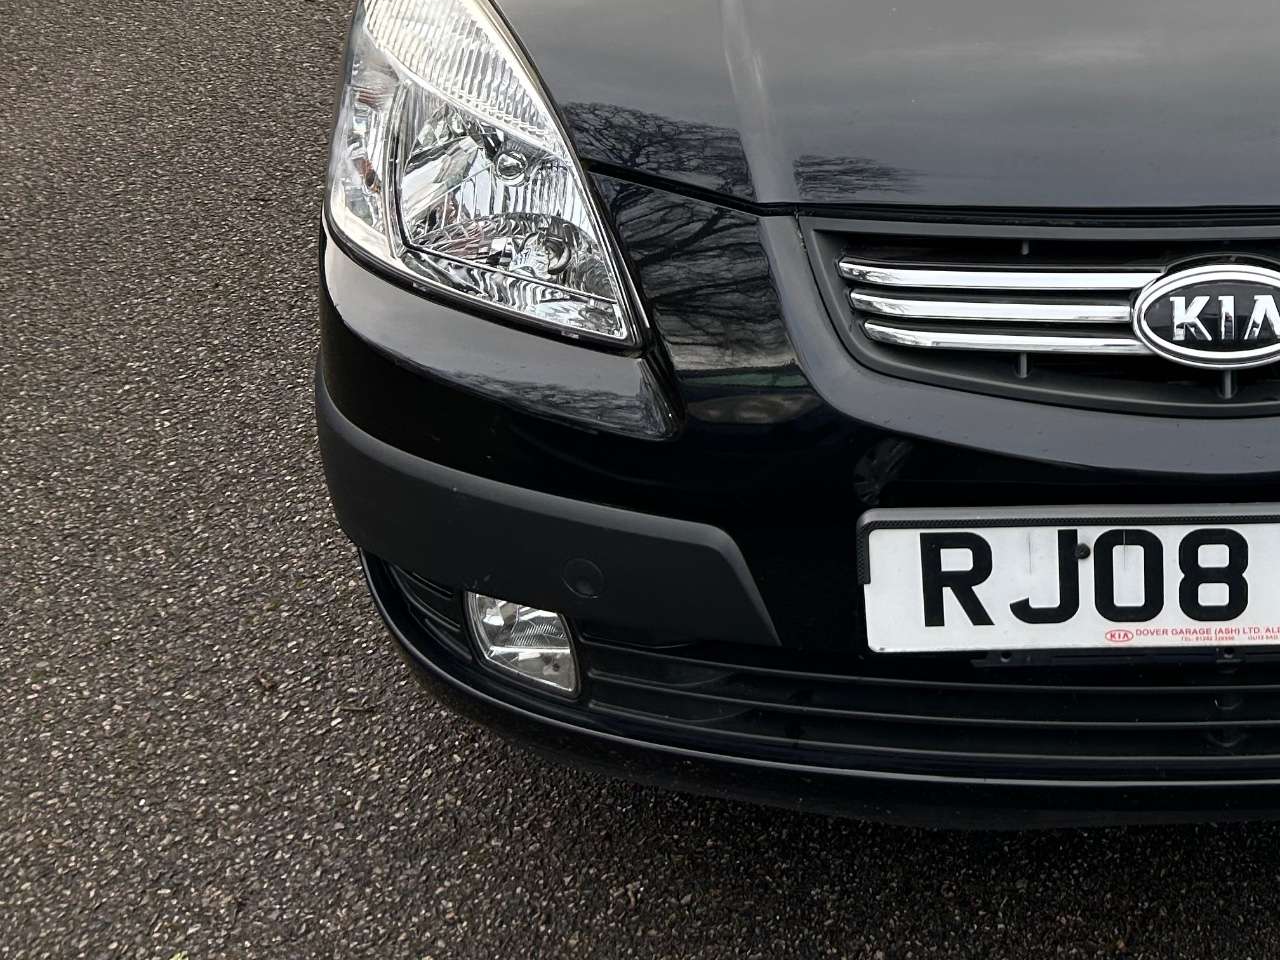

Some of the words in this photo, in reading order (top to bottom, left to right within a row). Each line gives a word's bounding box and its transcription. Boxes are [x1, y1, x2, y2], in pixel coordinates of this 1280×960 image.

[918, 528, 1249, 628] RJ08
[1135, 628, 1169, 636] DOVER
[1171, 627, 1212, 636] GARAGE
[1214, 626, 1240, 637] (ASH)
